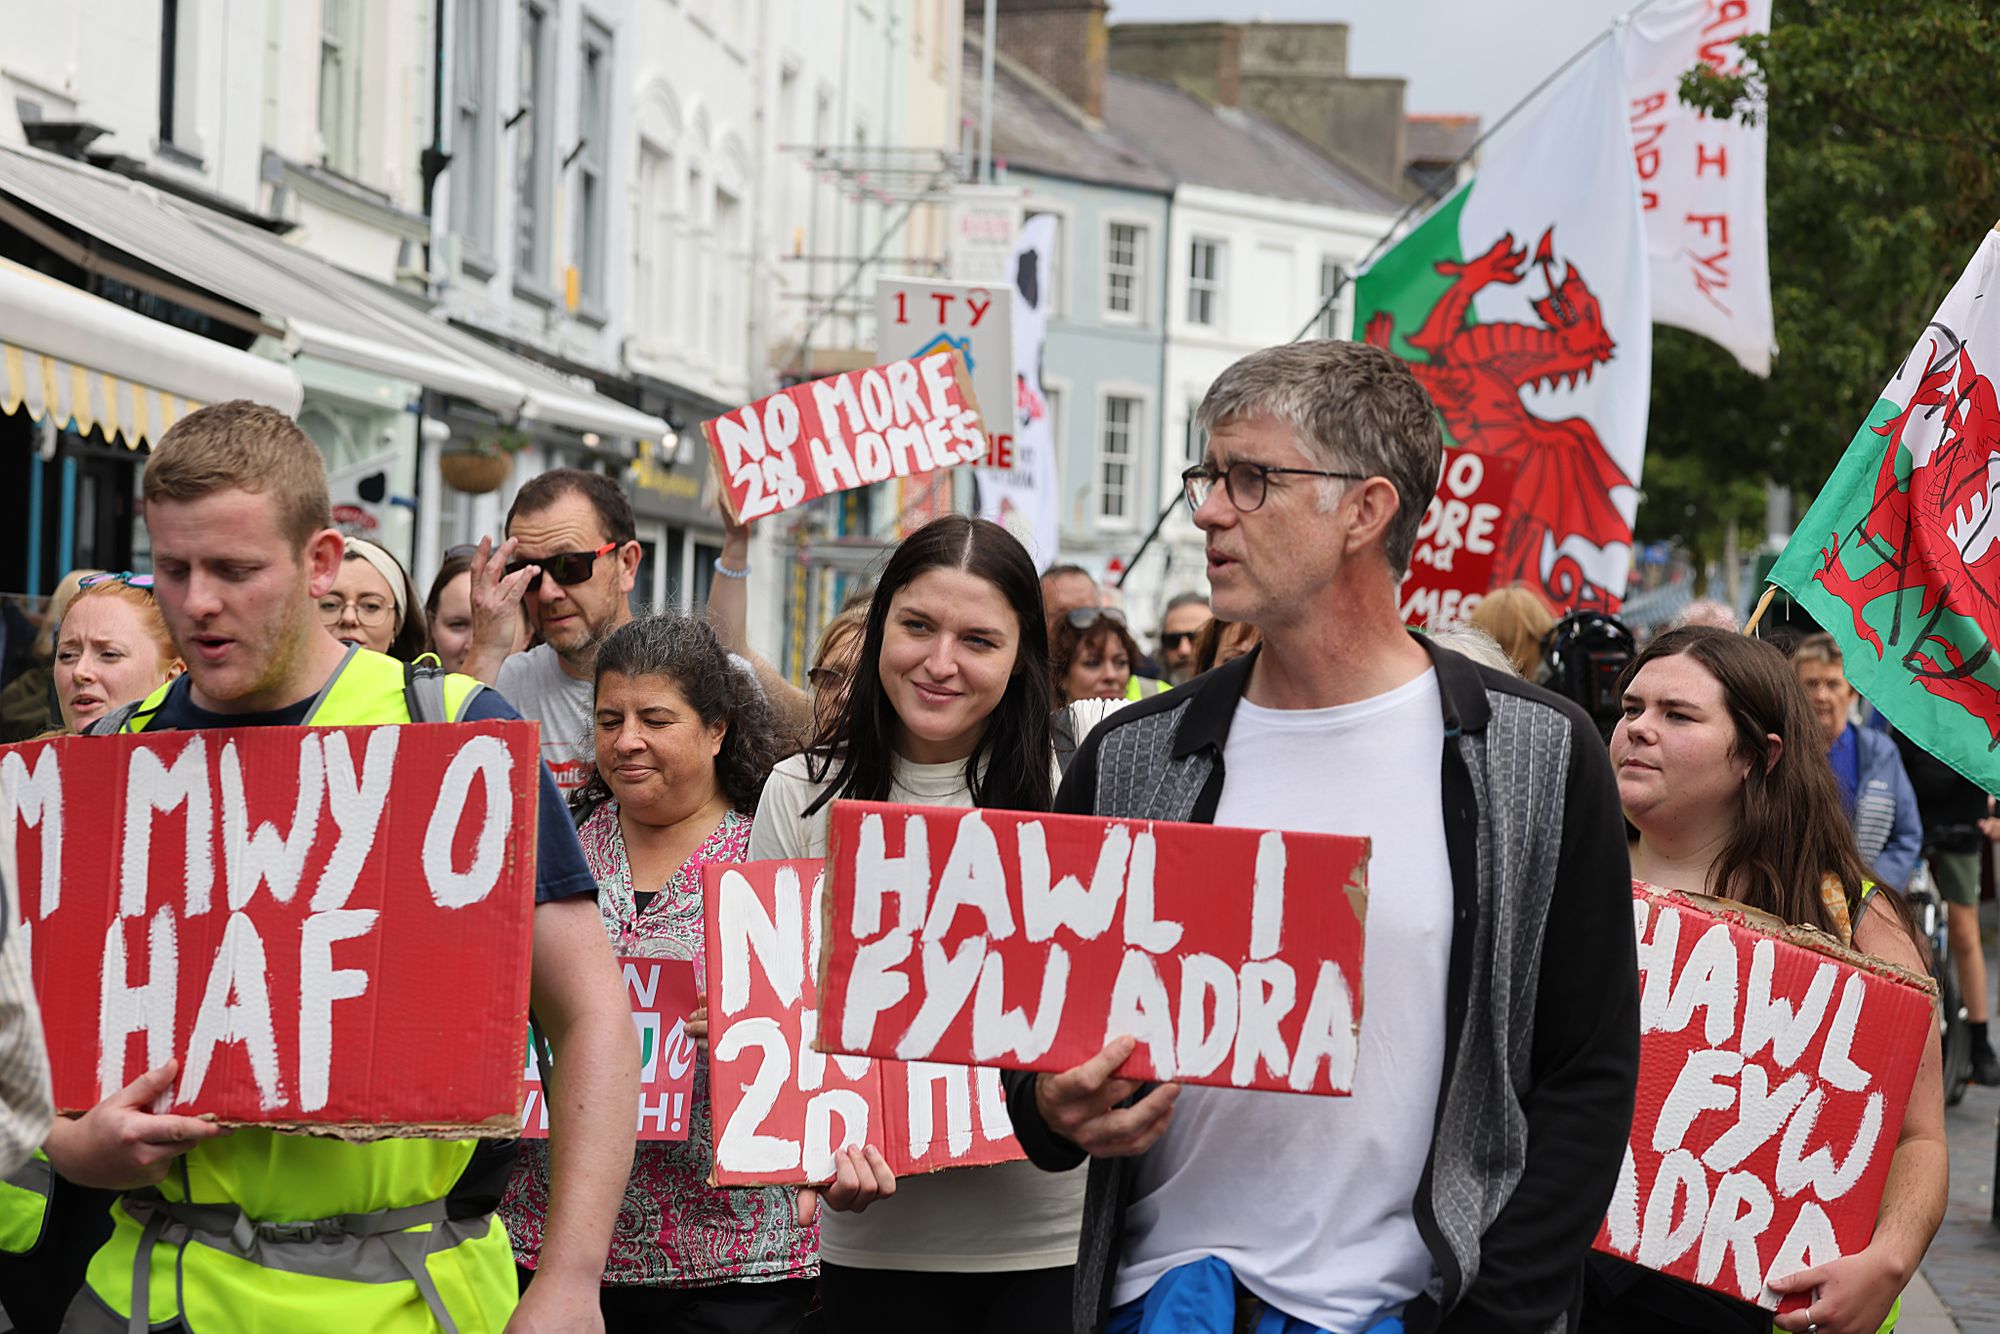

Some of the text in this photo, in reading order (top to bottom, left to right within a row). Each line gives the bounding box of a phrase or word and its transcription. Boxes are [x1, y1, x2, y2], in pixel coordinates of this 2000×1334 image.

[716, 393, 799, 477] NO
[810, 352, 960, 440] MORE
[809, 409, 986, 493] HOMES
[120, 725, 400, 919] MWY
[421, 735, 513, 910] O
[851, 809, 1287, 962] HAWL I
[97, 903, 381, 1113] HAF
[840, 927, 1357, 1094] FYW ADRA
[1632, 898, 1872, 1091] HAWL
[1652, 1047, 1885, 1202] FYW
